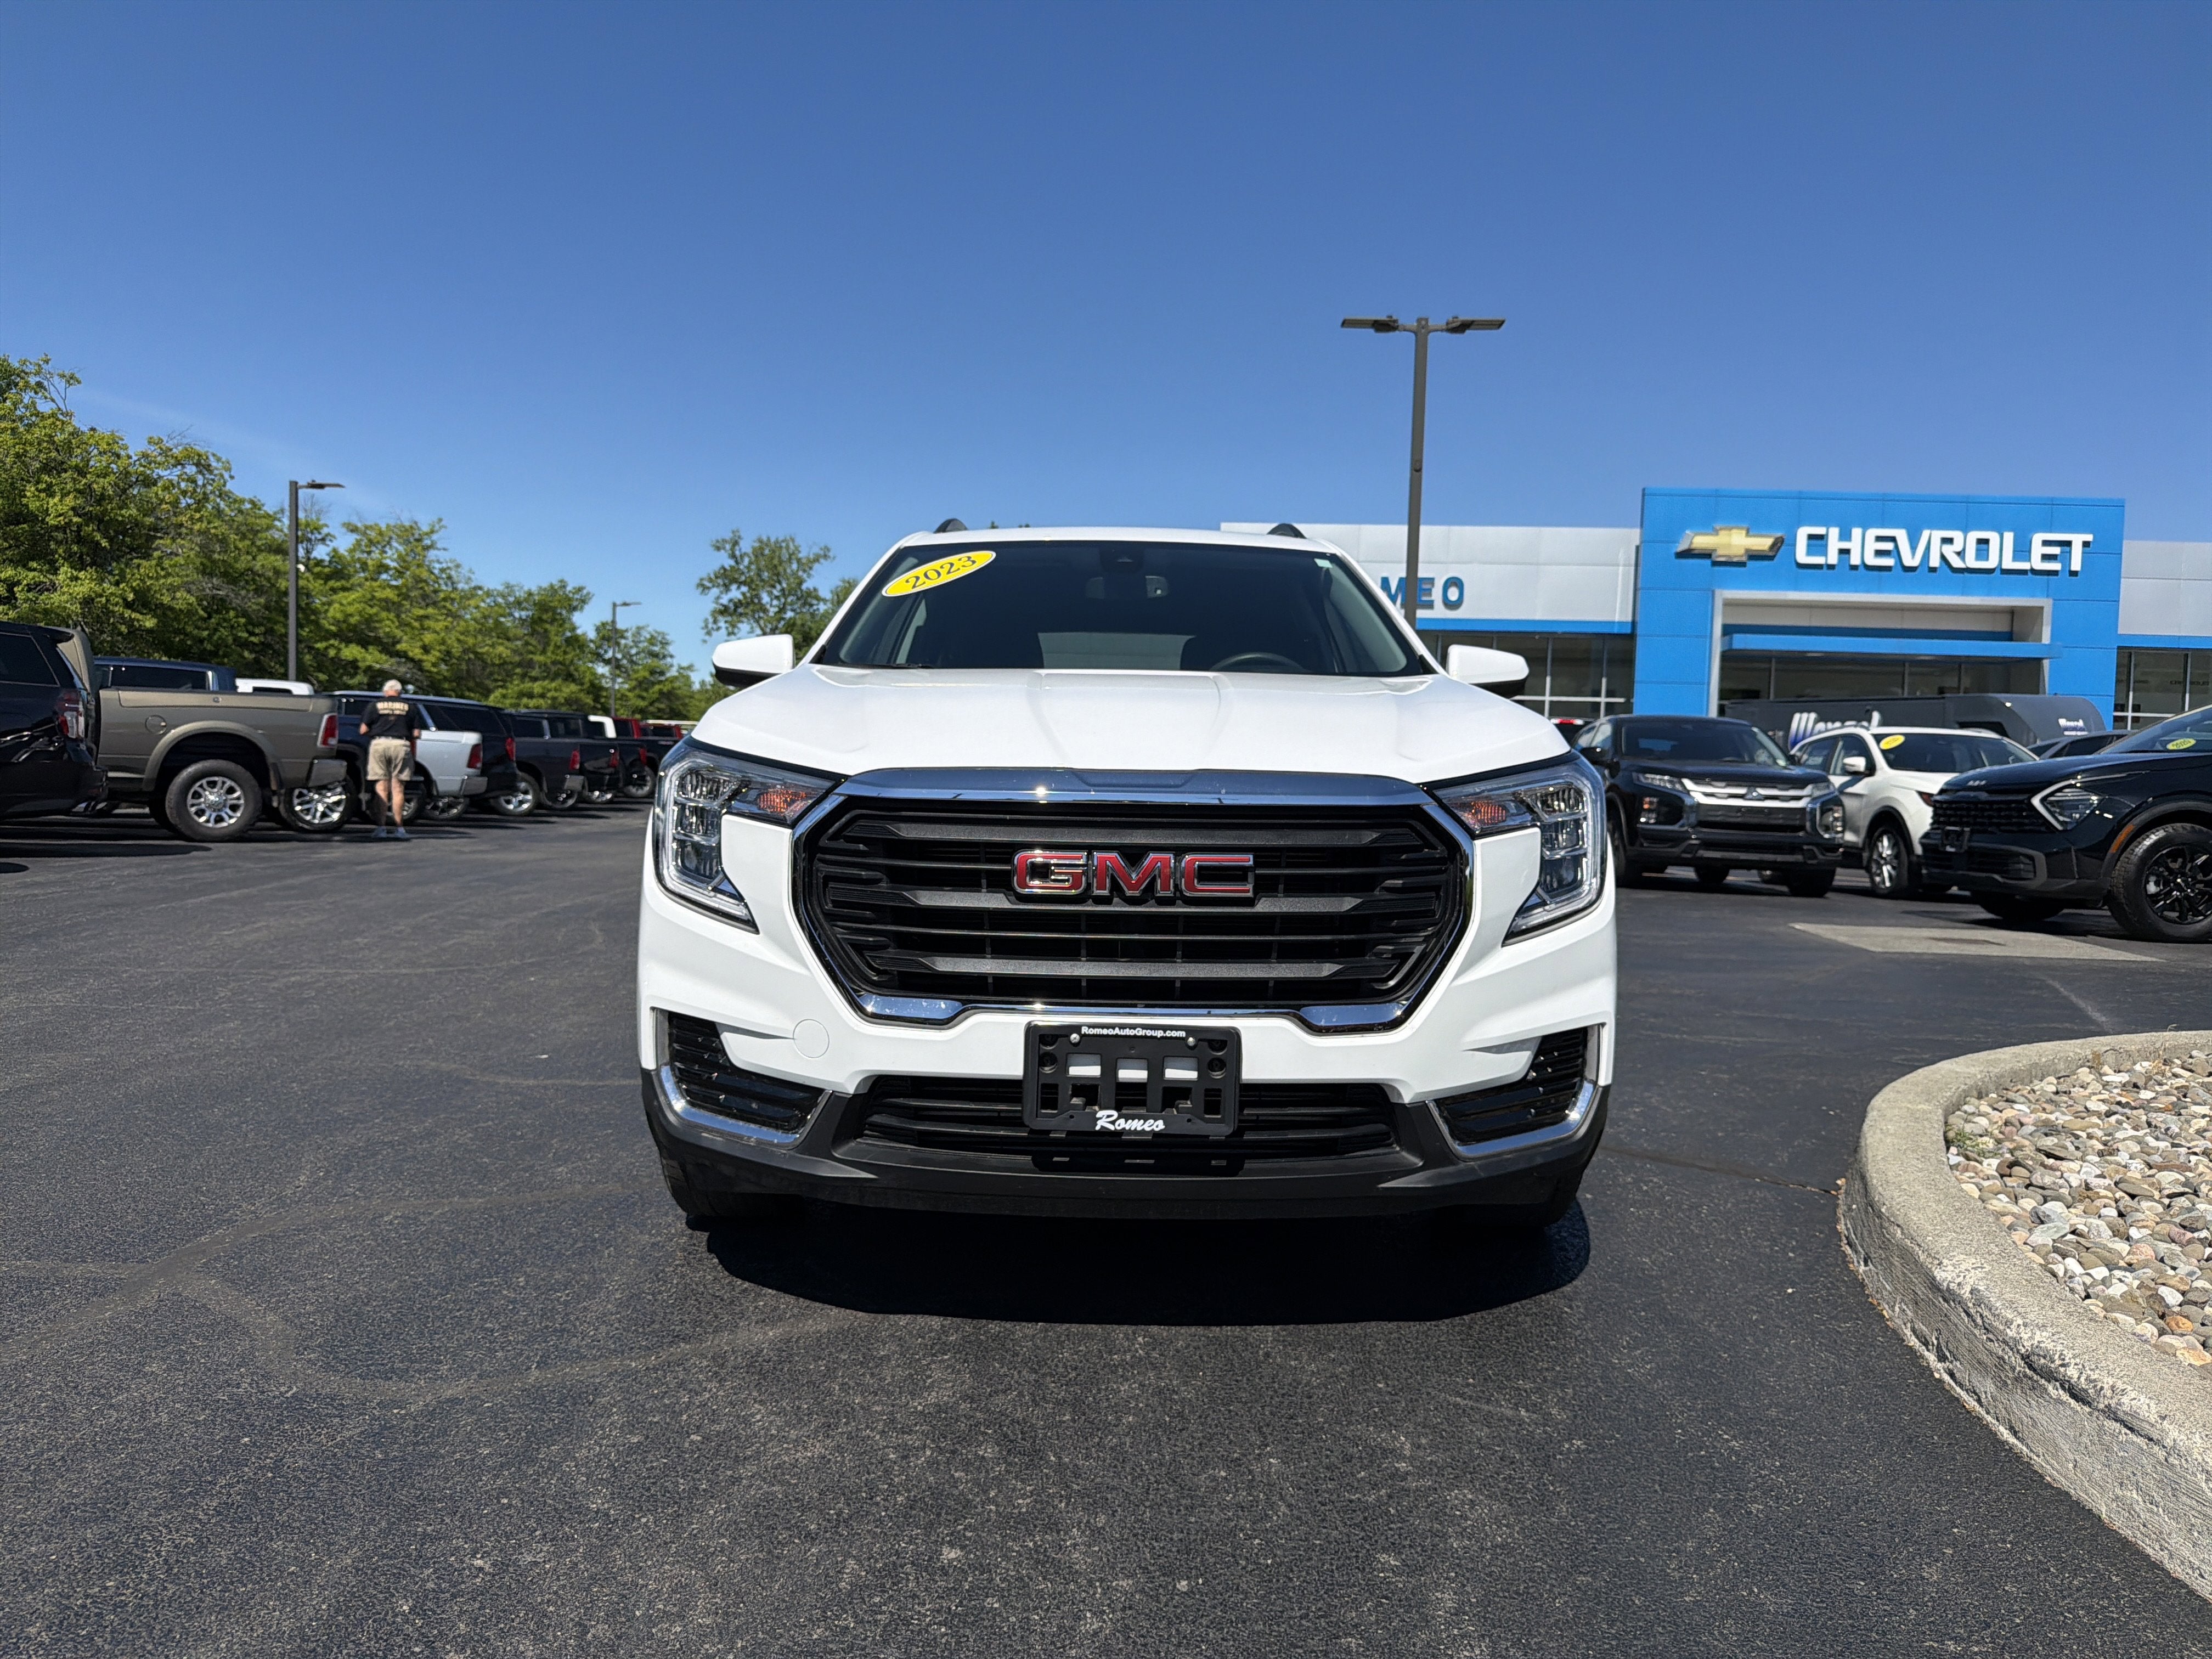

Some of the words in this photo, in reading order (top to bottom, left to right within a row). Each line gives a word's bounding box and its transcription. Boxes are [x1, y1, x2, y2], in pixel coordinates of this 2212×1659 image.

[1795, 526, 2094, 572] CHEVROLET
[905, 555, 977, 590] 2023
[1011, 849, 1255, 897] GMC
[1081, 1026, 1186, 1038] RomeoAutoGroup.com
[1095, 1110, 1165, 1131] Romeo
